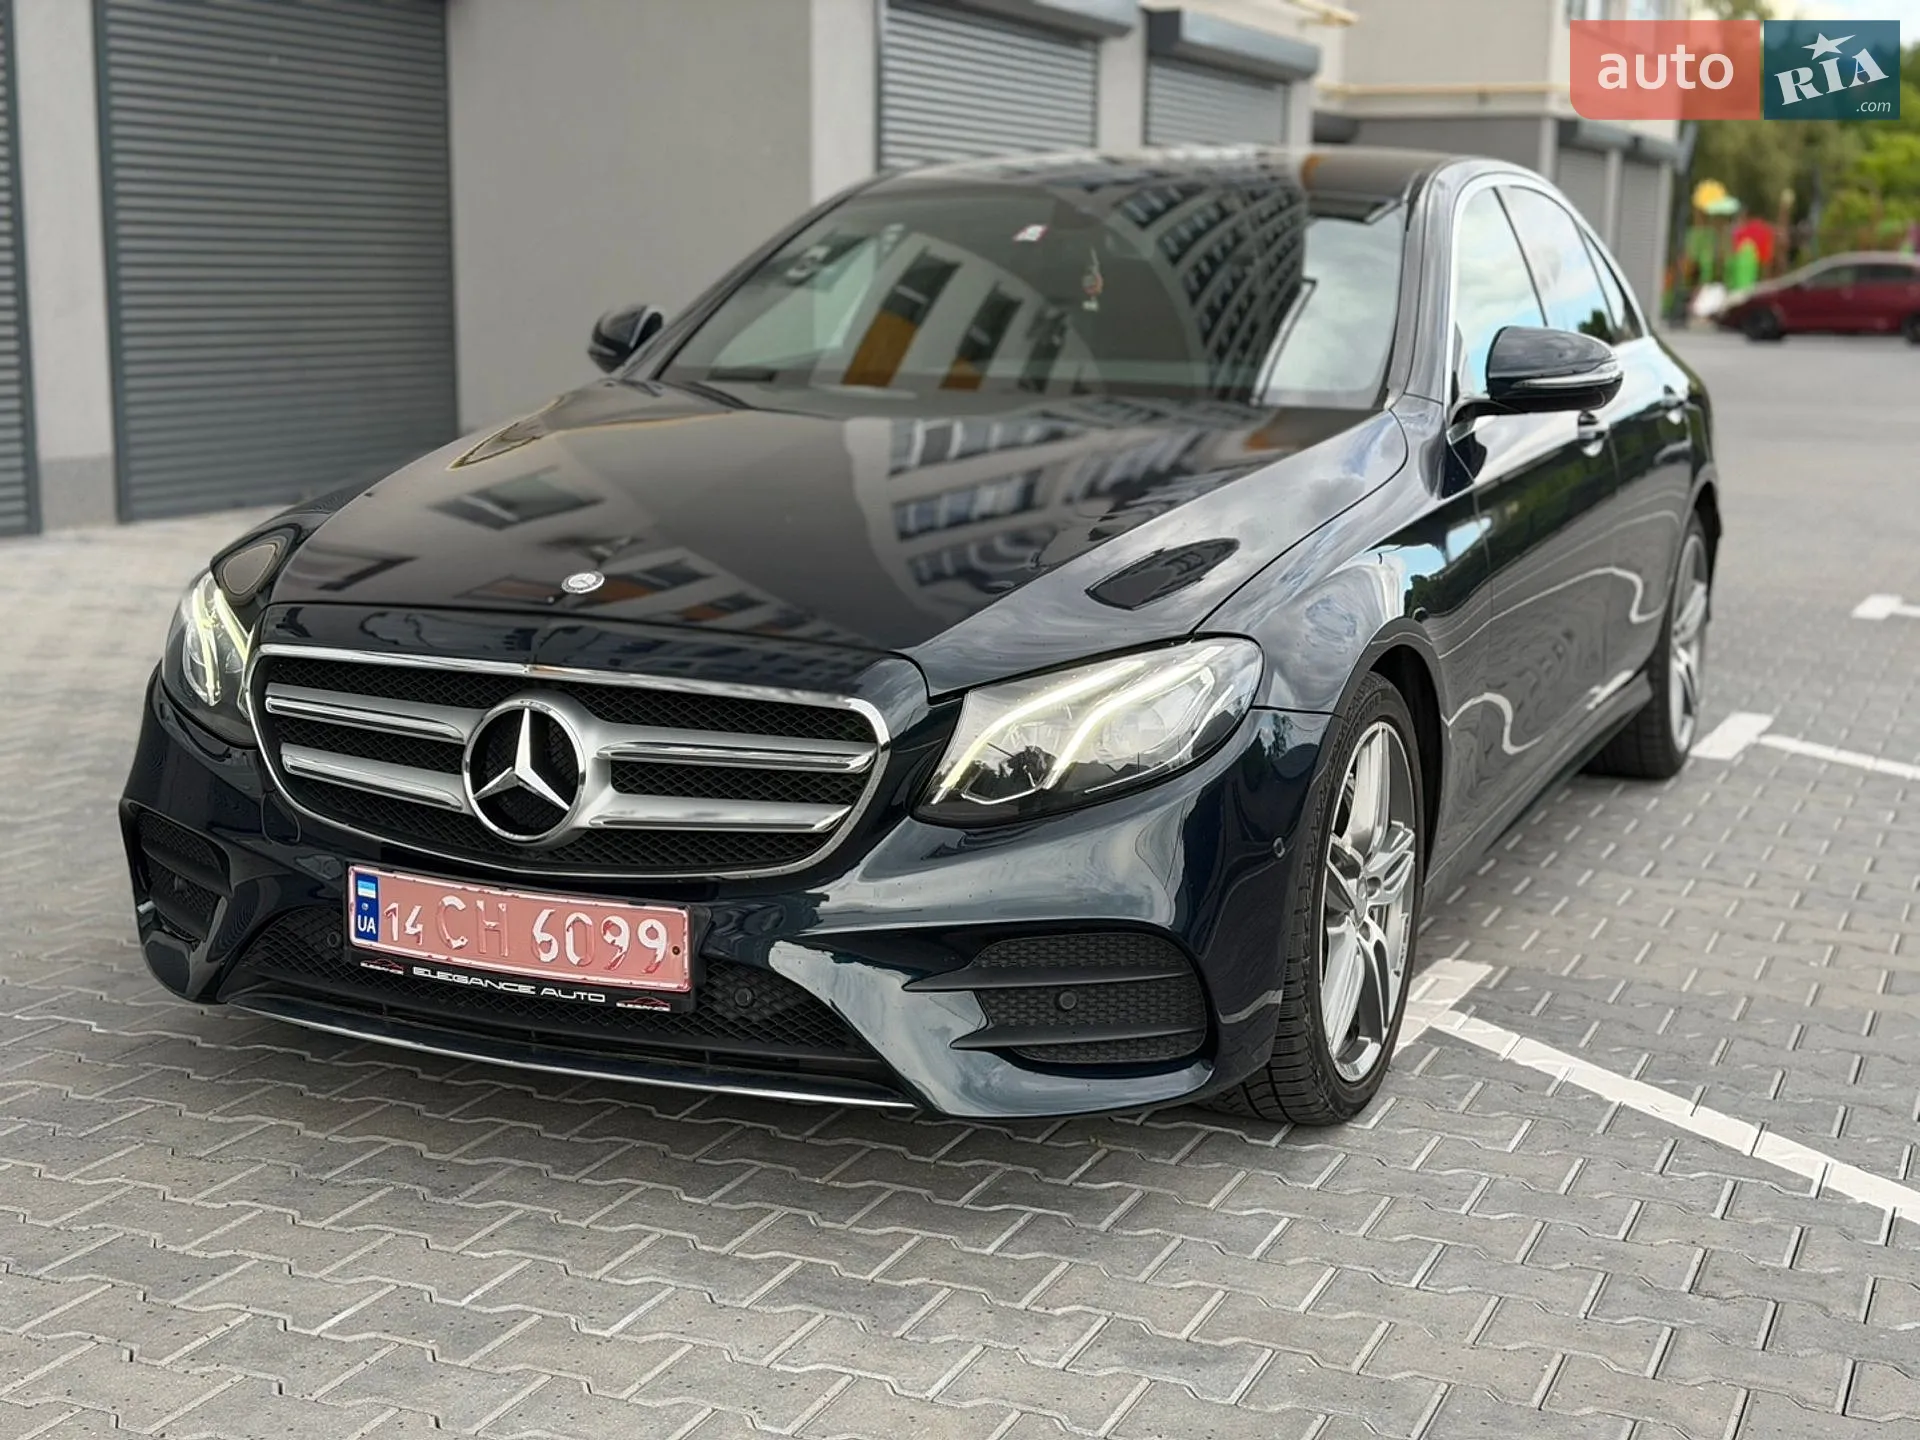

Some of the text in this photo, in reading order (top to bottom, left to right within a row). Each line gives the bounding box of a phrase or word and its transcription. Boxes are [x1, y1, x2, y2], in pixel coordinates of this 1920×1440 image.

[357, 914, 376, 934] UA
[383, 894, 668, 974] 14 CH 6099
[412, 966, 606, 1003] ELEGANCE AUTO
